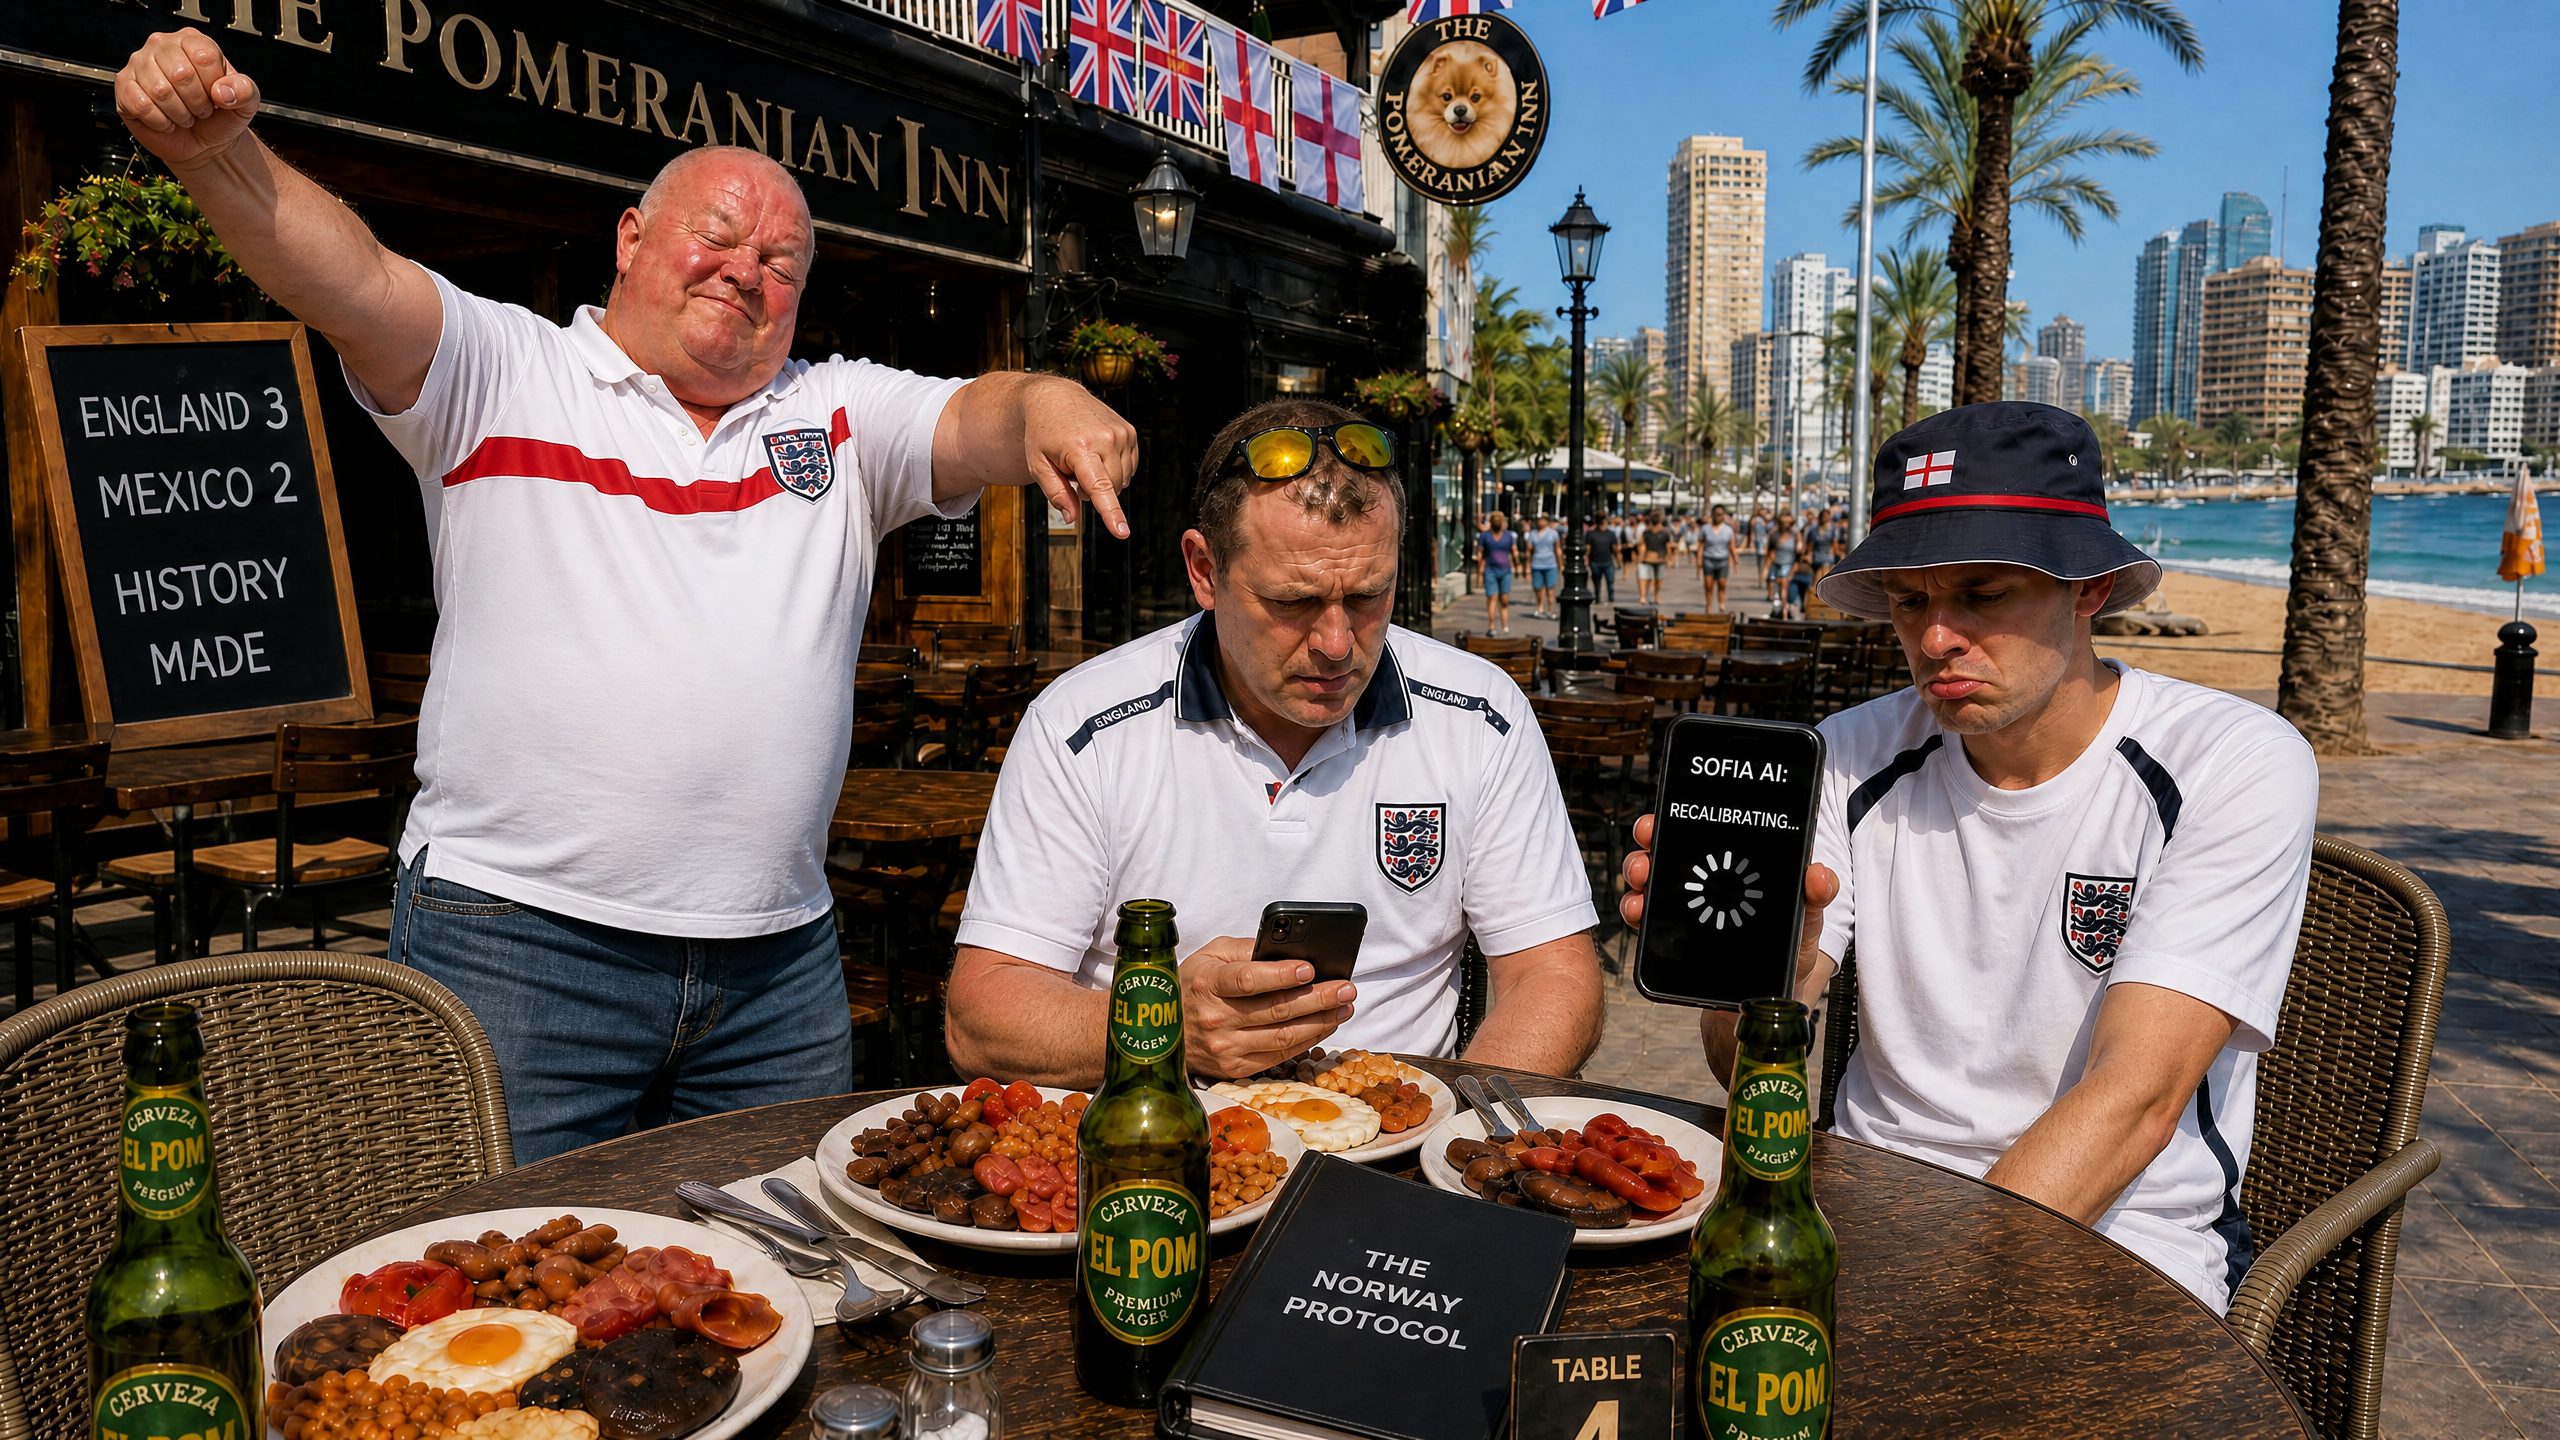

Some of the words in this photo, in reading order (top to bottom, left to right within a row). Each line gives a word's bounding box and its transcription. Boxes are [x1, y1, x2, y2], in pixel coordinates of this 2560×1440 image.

[1435, 18, 1492, 41] THE
[379, 0, 882, 191] POMERANIAN
[896, 115, 1010, 224] INN
[1385, 91, 1526, 192] POMERANIAN
[1516, 79, 1538, 138] INN
[79, 391, 250, 438] ENGLAND
[263, 387, 288, 430] 3
[98, 467, 254, 518] MEXICO
[269, 461, 298, 503] 2
[114, 557, 288, 615] HISTORY
[150, 631, 271, 685] MADE
[1420, 686, 1468, 707] ENGLAND
[1094, 699, 1152, 728] ENGLAND
[1690, 756, 1754, 780] SOFIA
[1759, 762, 1788, 783] AI:
[1669, 802, 1800, 831] RECALIBRATING...
[1118, 975, 1174, 997] CERVEZA
[1114, 998, 1133, 1026] EL
[1137, 1000, 1178, 1027] POM
[1742, 1080, 1803, 1102] CERVEZA
[127, 1106, 197, 1132] CERVEZA
[1735, 1104, 1758, 1138] EL
[1763, 1107, 1807, 1139] POM
[123, 1136, 146, 1172] EL
[150, 1134, 205, 1172] POM
[1100, 1195, 1187, 1225] CERVEZA
[1090, 1229, 1121, 1277] EL
[1128, 1231, 1197, 1279] POM
[1365, 1249, 1431, 1279] THE
[1104, 1287, 1182, 1311] PREMIUM
[1312, 1270, 1463, 1315] NORWAY
[1116, 1308, 1169, 1326] LAGER
[1282, 1296, 1467, 1350] PROTOCOL
[1720, 1325, 1818, 1356] CERVEZA
[1551, 1354, 1642, 1383] TABLE
[109, 1382, 221, 1417] CERVEZA
[1708, 1360, 1747, 1414] EL
[1755, 1362, 1826, 1416] POM
